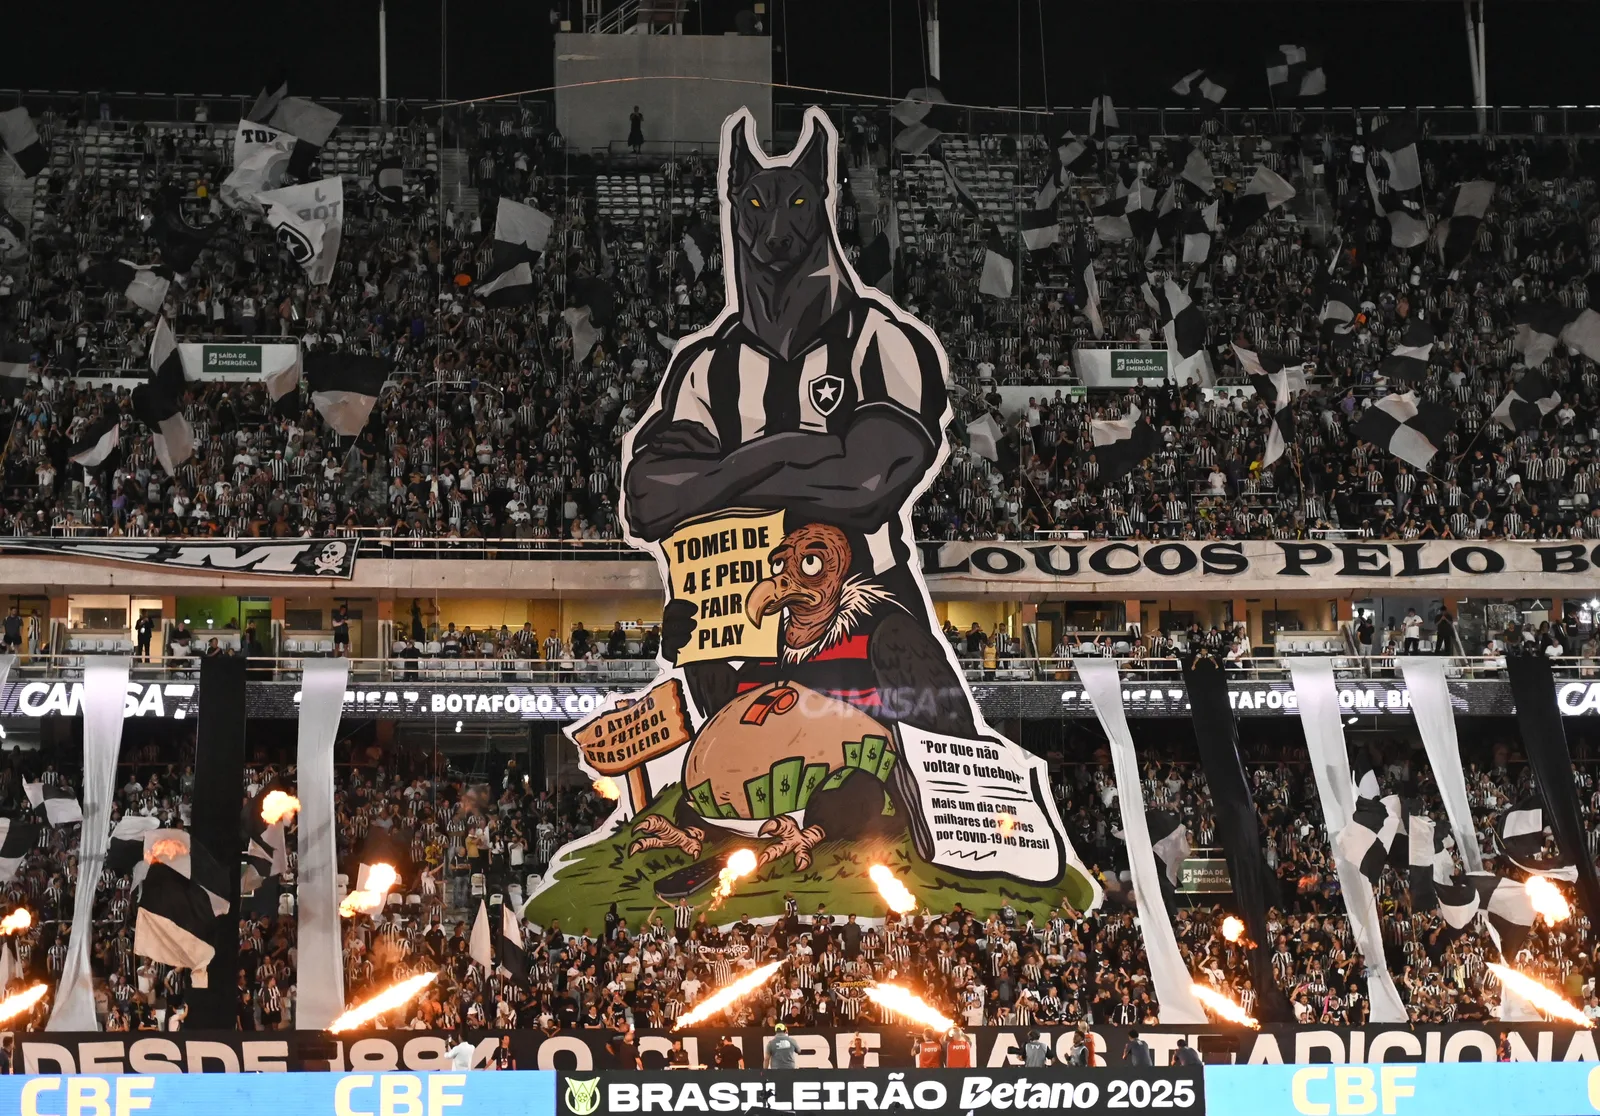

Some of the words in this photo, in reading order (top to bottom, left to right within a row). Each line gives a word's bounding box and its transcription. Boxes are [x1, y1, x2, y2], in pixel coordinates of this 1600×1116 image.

[673, 528, 738, 564] TOMEI
[742, 525, 770, 550] DE
[916, 541, 1249, 576] LOUCOS
[1274, 541, 1505, 577] PELO
[683, 571, 697, 595] 4
[701, 567, 711, 592] E
[716, 559, 764, 588] PEDI
[700, 593, 743, 620] FAIR
[698, 623, 745, 650] PLAY
[594, 725, 603, 738] O
[607, 697, 655, 734] ATRASO
[611, 710, 667, 749] FUTEBOL
[587, 727, 670, 763] BRASILEIRO
[950, 743, 974, 757] que
[976, 746, 999, 760] não
[923, 760, 960, 774] voltar
[963, 765, 971, 776] o
[931, 797, 957, 810] Mais
[959, 800, 976, 811] um
[977, 801, 994, 813] dia
[995, 804, 1017, 815] com
[934, 813, 981, 828] milhares
[982, 817, 996, 829] de
[936, 830, 953, 841] por
[955, 831, 1002, 844] COVID-19
[1003, 835, 1017, 847] no
[1019, 835, 1050, 849] Brasil
[1193, 868, 1213, 876] SAÍDA
[537, 1036, 593, 1071] O
[20, 1077, 156, 1116] CBF
[334, 1073, 467, 1116] CBF
[607, 1072, 948, 1113] BRASILEIRÃO
[959, 1076, 1099, 1110] Betano
[1107, 1078, 1196, 1109] 2025
[1291, 1065, 1418, 1116] CBF
